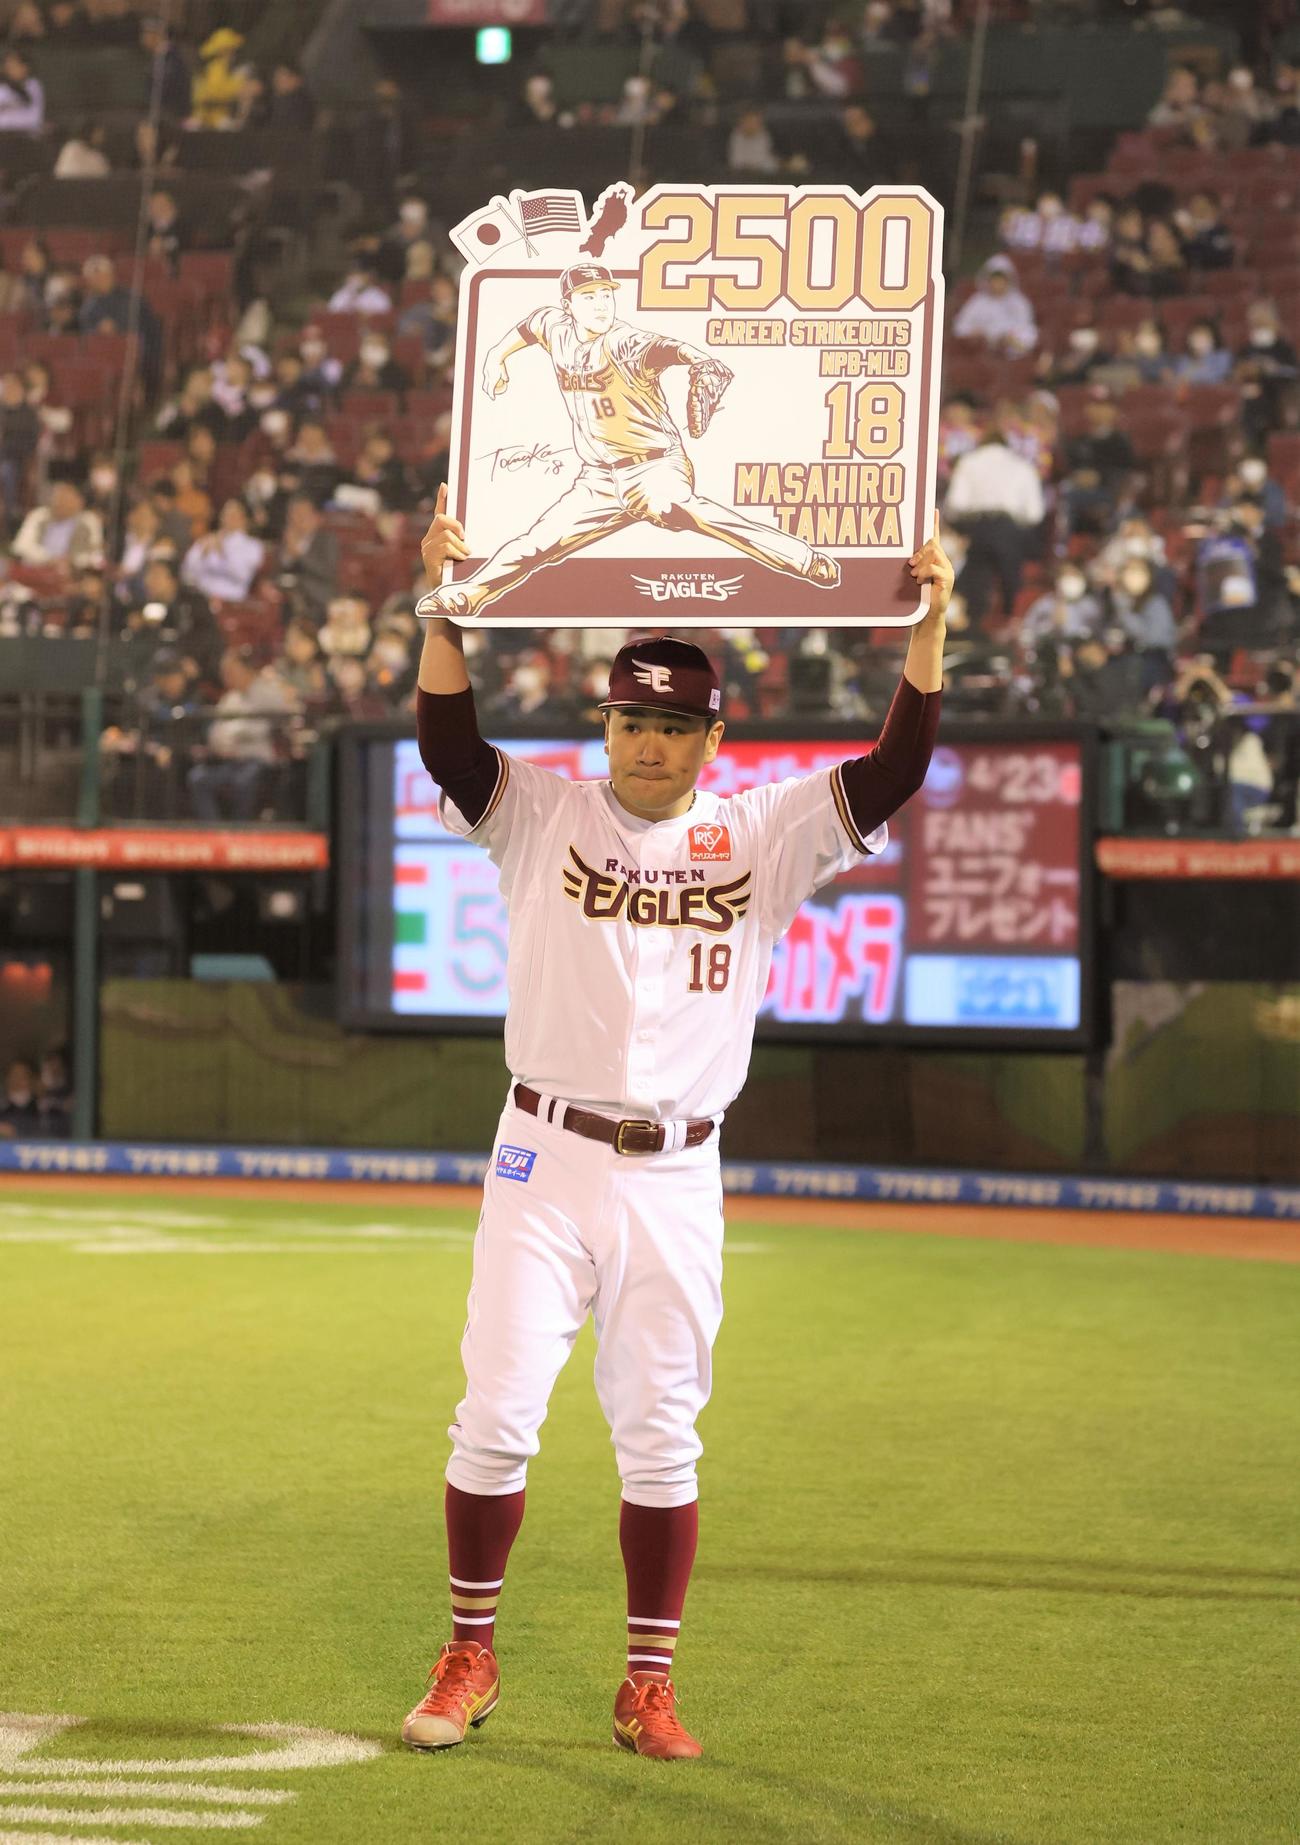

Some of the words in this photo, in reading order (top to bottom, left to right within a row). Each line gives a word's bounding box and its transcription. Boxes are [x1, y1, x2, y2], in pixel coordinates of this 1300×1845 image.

[637, 193, 934, 311] 2500
[706, 319, 786, 346] CAREER
[789, 319, 911, 346] STRIKEOUTS
[819, 350, 910, 377] NPB-MLB
[592, 397, 616, 420] 18
[822, 381, 905, 459] 18
[734, 463, 905, 506] MASAHIRO
[774, 505, 903, 547] TANAKA
[637, 577, 738, 601] EAGLES
[694, 831, 714, 845] IRIS
[605, 858, 705, 884] RAKUTEN
[572, 862, 746, 936] EAGLES
[688, 943, 732, 993] 18
